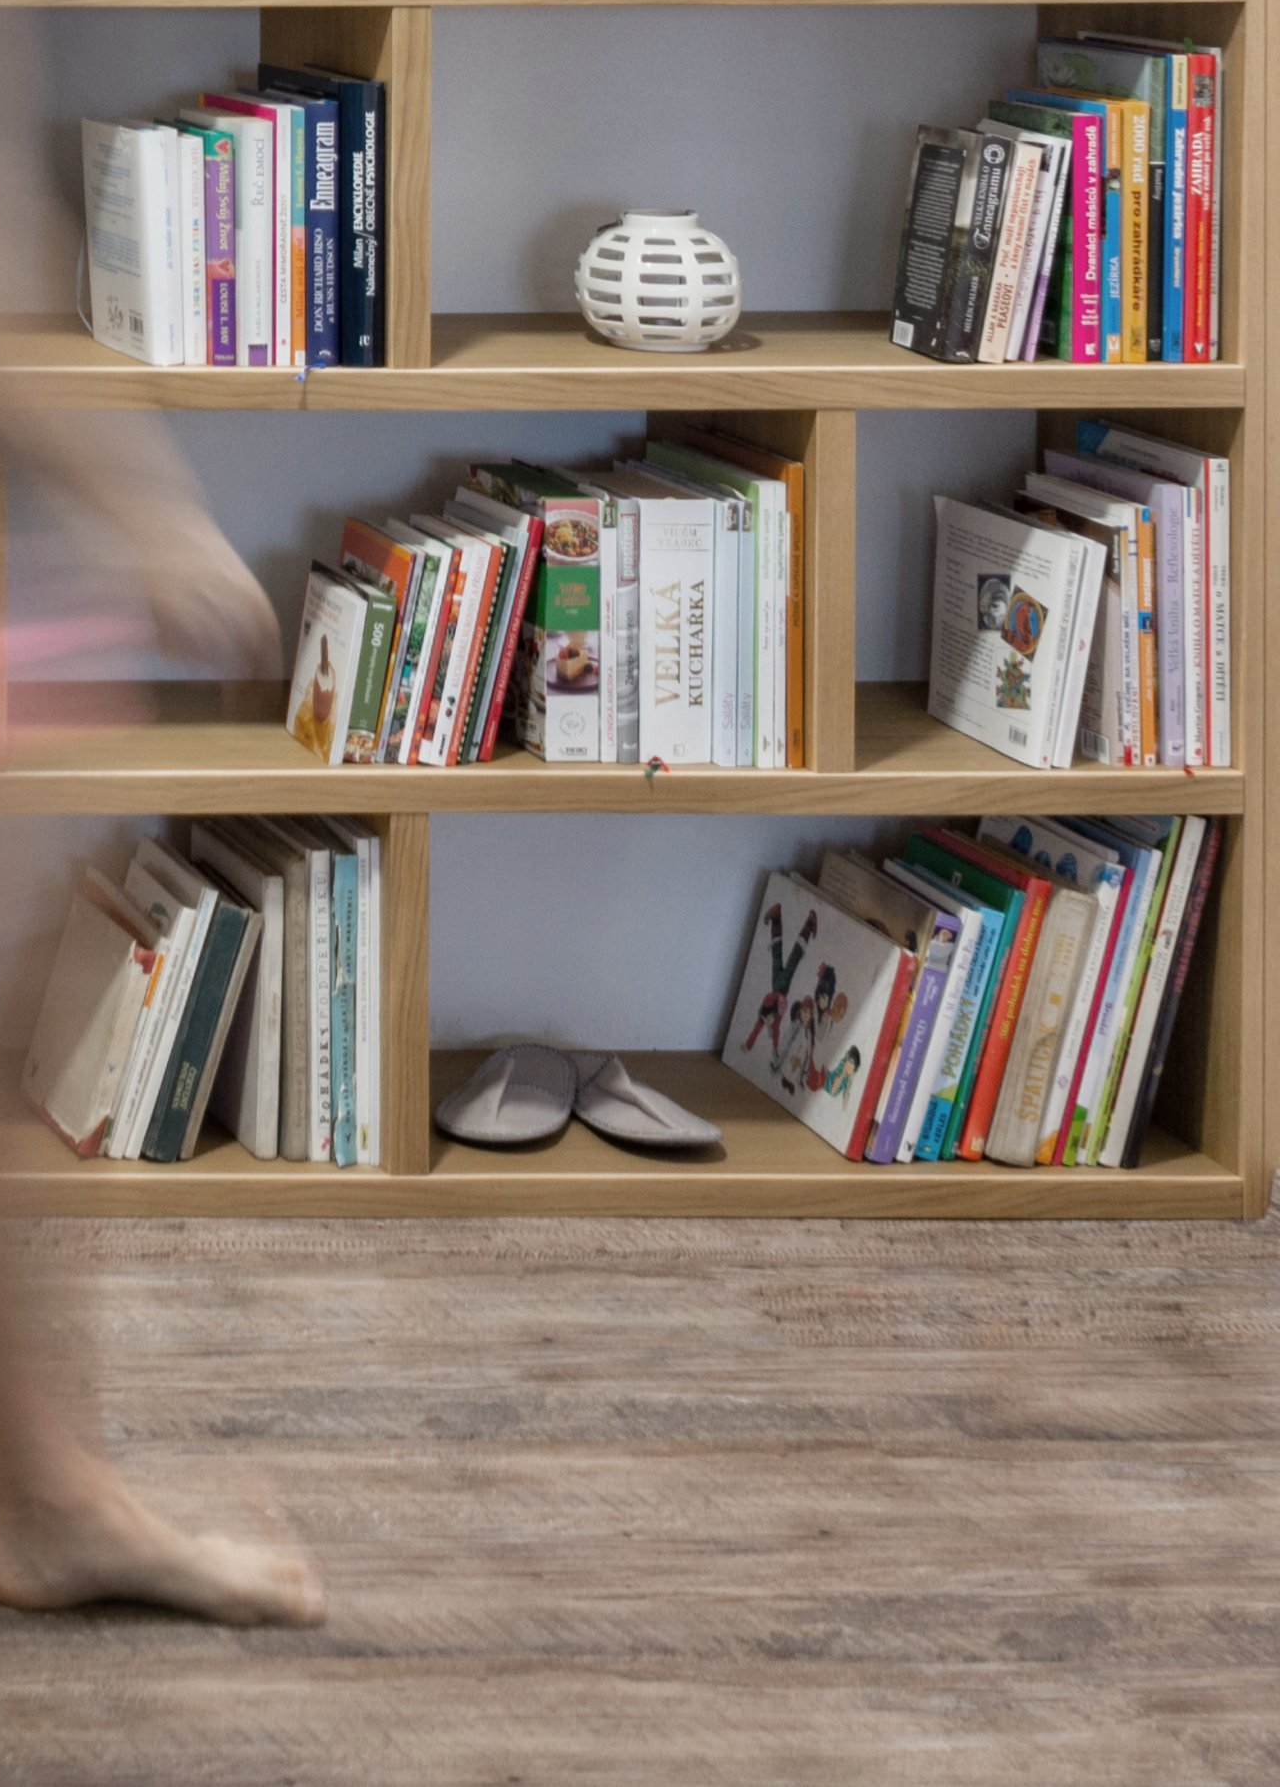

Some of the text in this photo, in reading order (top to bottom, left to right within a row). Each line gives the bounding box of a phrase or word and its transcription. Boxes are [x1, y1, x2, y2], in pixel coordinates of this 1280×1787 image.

[310, 122, 336, 209] Enneagram
[362, 111, 375, 230] OBECNÉ PSYCHOLOGIE
[1084, 125, 1096, 172] zahradě
[1188, 131, 1205, 194] ZAHRADA
[216, 162, 231, 249] Miluj Svůj Život
[352, 152, 364, 230] ENCYKLOPEDIE
[970, 166, 1009, 250] Enneagramu
[975, 172, 992, 199] KNIHA
[1084, 187, 1095, 228] měsíců
[970, 199, 987, 226] VELKÁ
[1131, 115, 1146, 310] 2000 rad pro zahrádkáře
[325, 238, 334, 284] HUDSON
[353, 238, 363, 267] Milan
[363, 238, 376, 295] Nakonečný
[1084, 233, 1095, 279] Dvanáct
[219, 283, 228, 314] LOUISE
[279, 277, 287, 303] CESTA
[313, 228, 323, 331] DON RICHARD RISO
[1108, 256, 1119, 297] JEZÍRKA
[326, 287, 334, 314] RUSS
[995, 283, 1015, 328] PEASEOVI
[219, 327, 227, 343] HAY
[1166, 507, 1179, 582] Reflexologie
[1166, 600, 1178, 634] kniha
[1192, 579, 1200, 615] MATCE
[649, 580, 680, 707] VELKÁ
[686, 579, 703, 707] KUCHAŘKA
[1192, 630, 1200, 666] KNIHA
[606, 666, 614, 703] AMERIKA
[722, 692, 734, 729] Saláty
[740, 693, 752, 729] Saláty
[939, 995, 975, 1079] POHÁDKY
